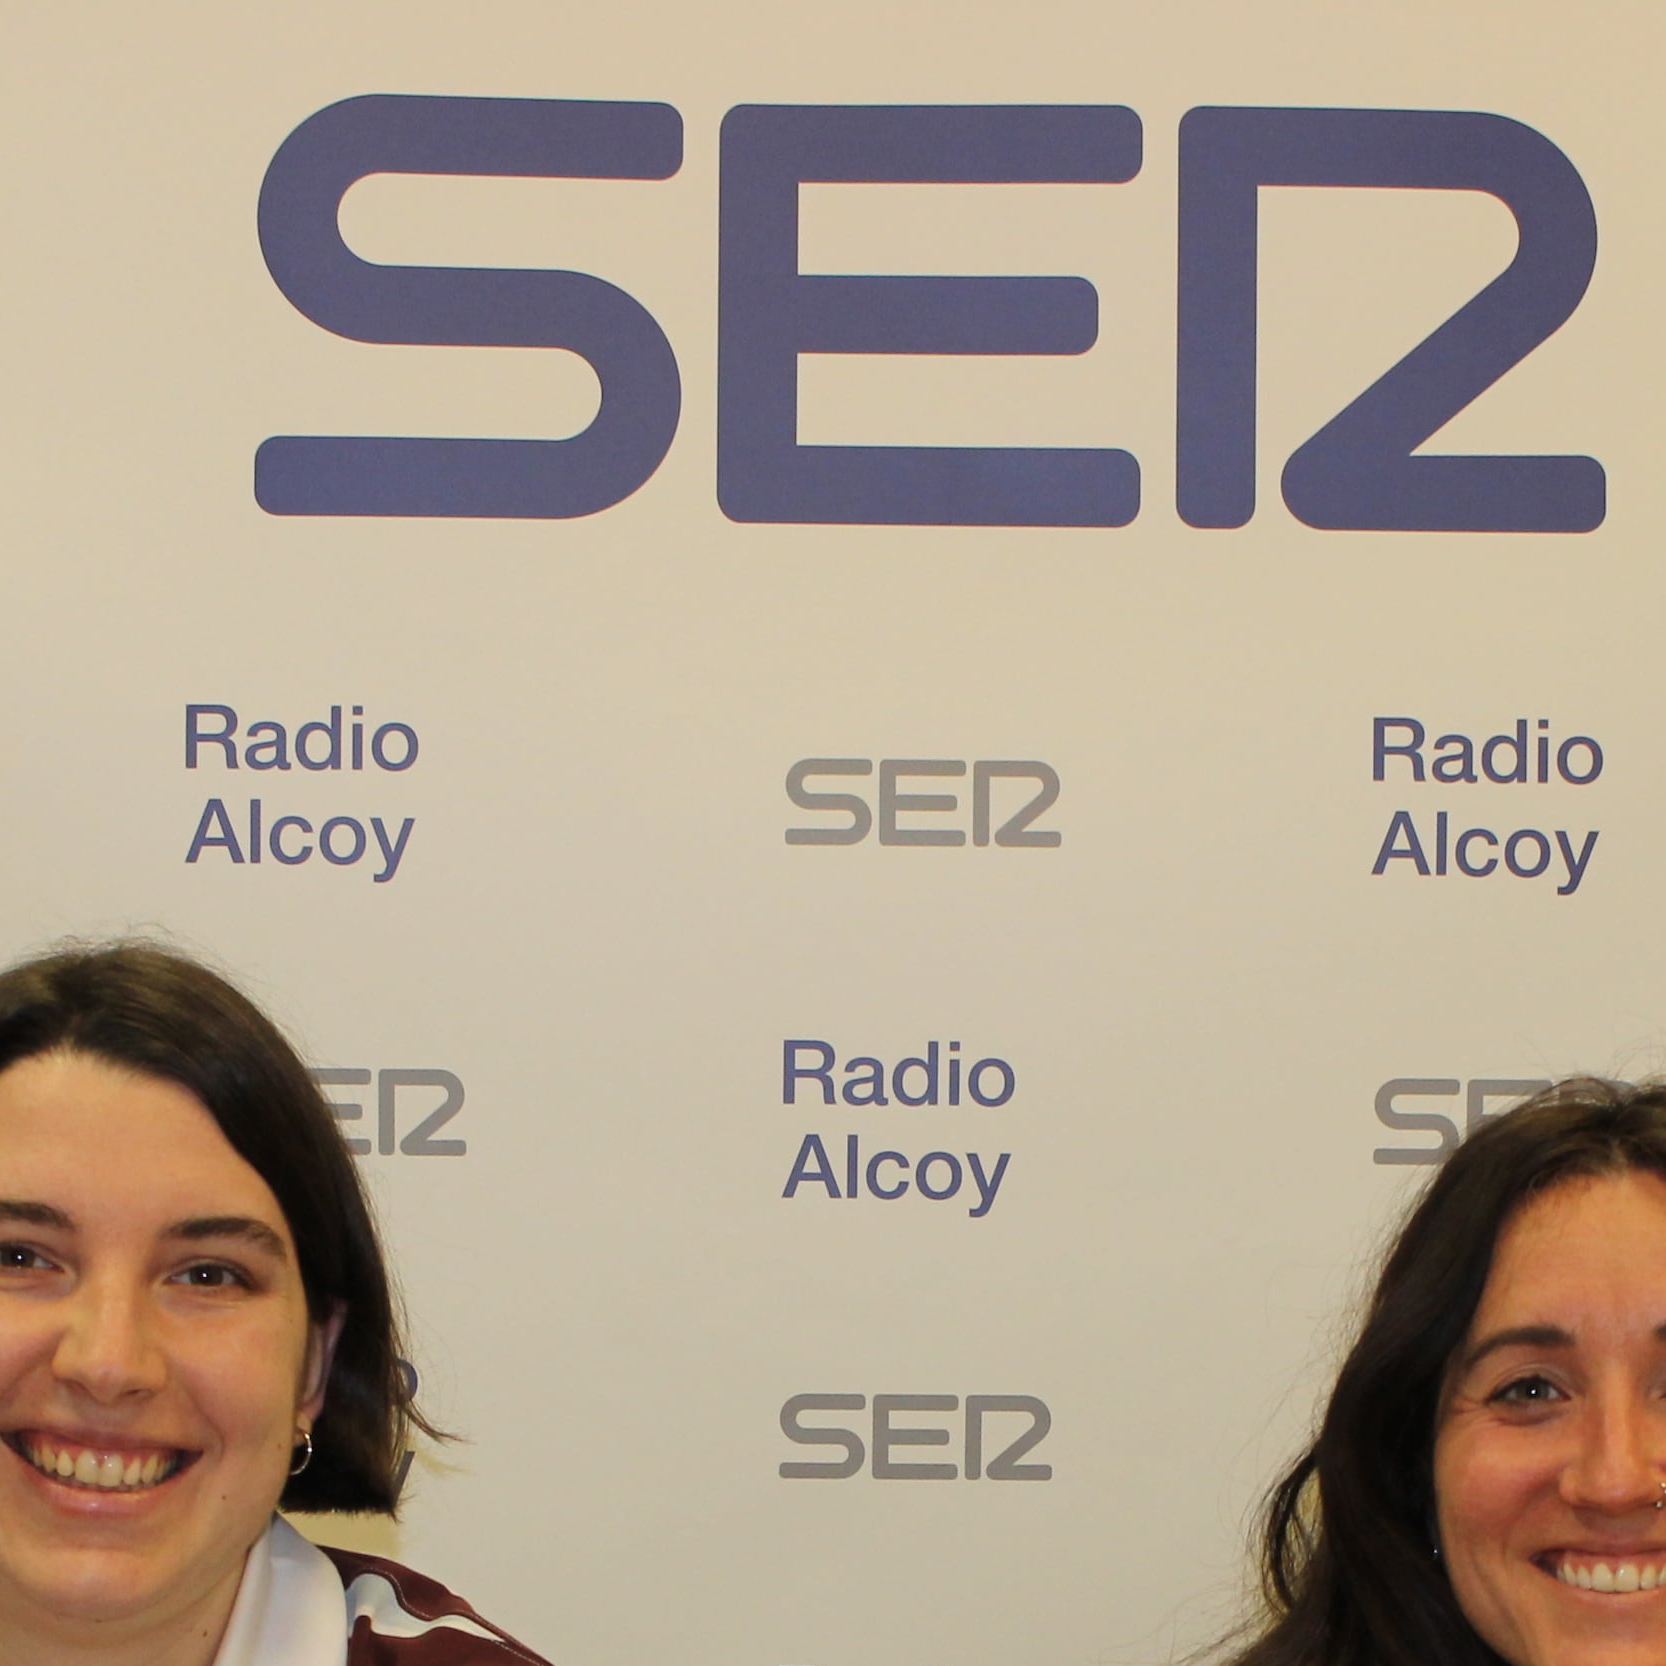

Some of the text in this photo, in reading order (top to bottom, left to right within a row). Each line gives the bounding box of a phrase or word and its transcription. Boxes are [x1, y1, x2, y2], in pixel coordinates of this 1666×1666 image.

[254, 94, 1607, 533] SER
[185, 704, 419, 772] Radio
[1373, 717, 1604, 785] Radio
[185, 798, 415, 883] Alcoy
[785, 759, 1061, 847] SER
[1371, 810, 1599, 896] Alcoy
[783, 1039, 1015, 1107] Radio
[782, 1134, 1011, 1218] Alcoy
[779, 1394, 1052, 1481] SER
